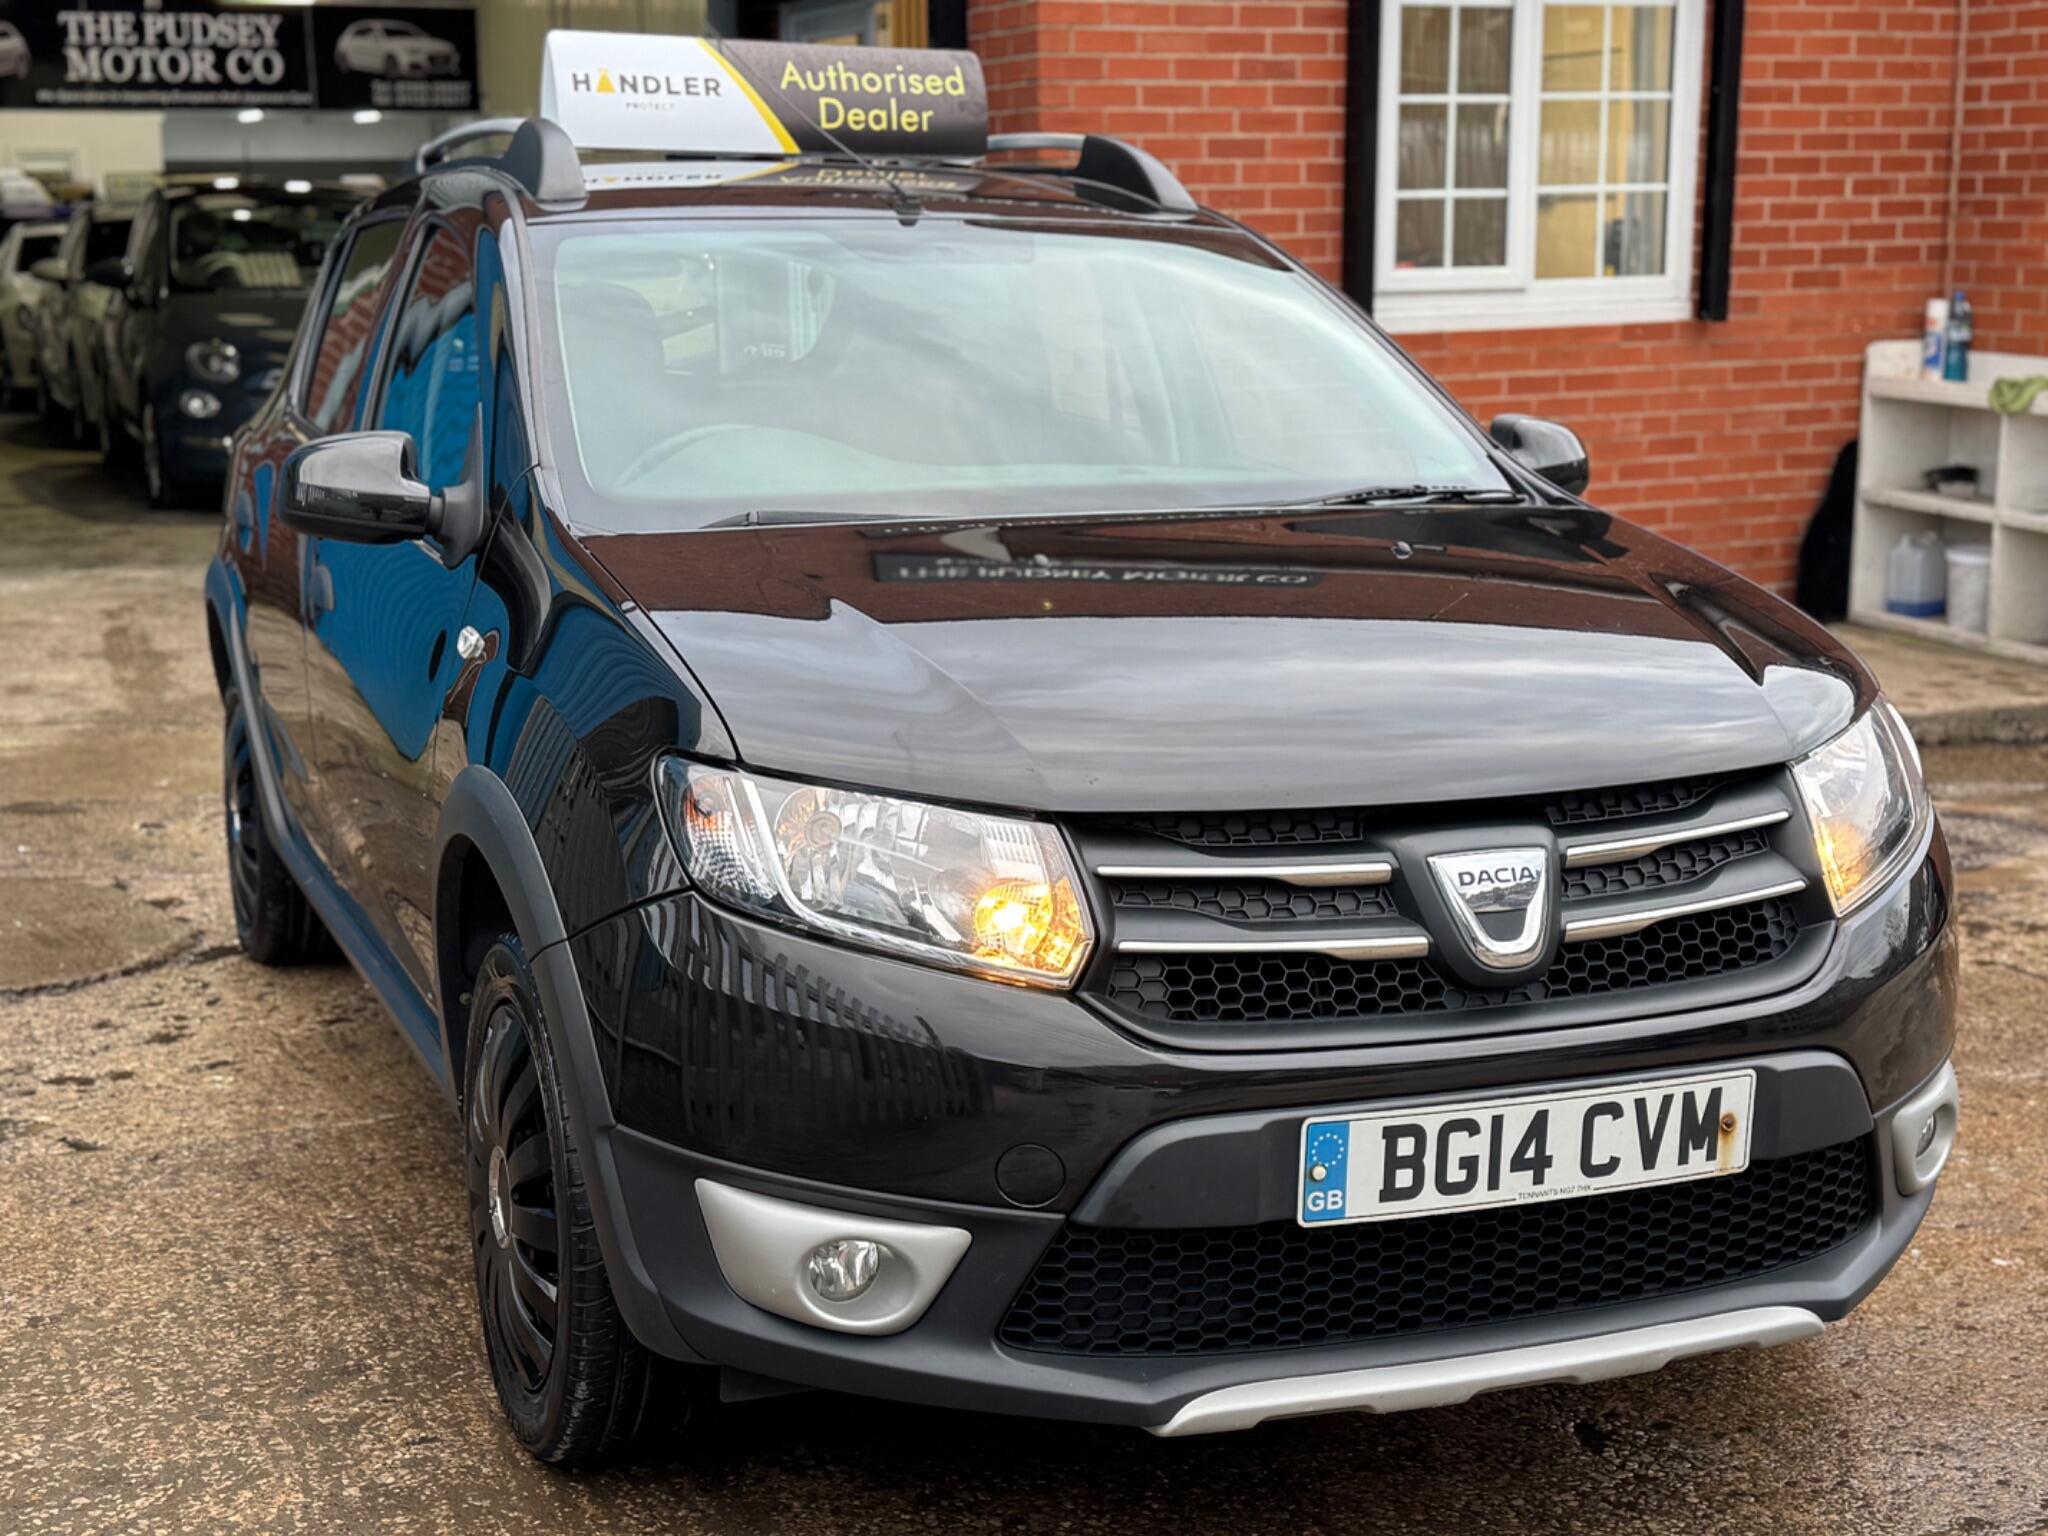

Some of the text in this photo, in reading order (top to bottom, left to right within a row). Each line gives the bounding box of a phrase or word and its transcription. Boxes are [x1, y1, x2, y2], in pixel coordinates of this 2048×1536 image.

[57, 10, 282, 49] THE PUDSEY
[63, 46, 285, 85] MOTOR CO
[780, 60, 966, 96] Authorised
[818, 96, 934, 132] Dealer
[1458, 866, 1535, 887] DACIA
[1379, 1086, 1723, 1203] BG14 CVM
[1306, 1189, 1344, 1212] GB
